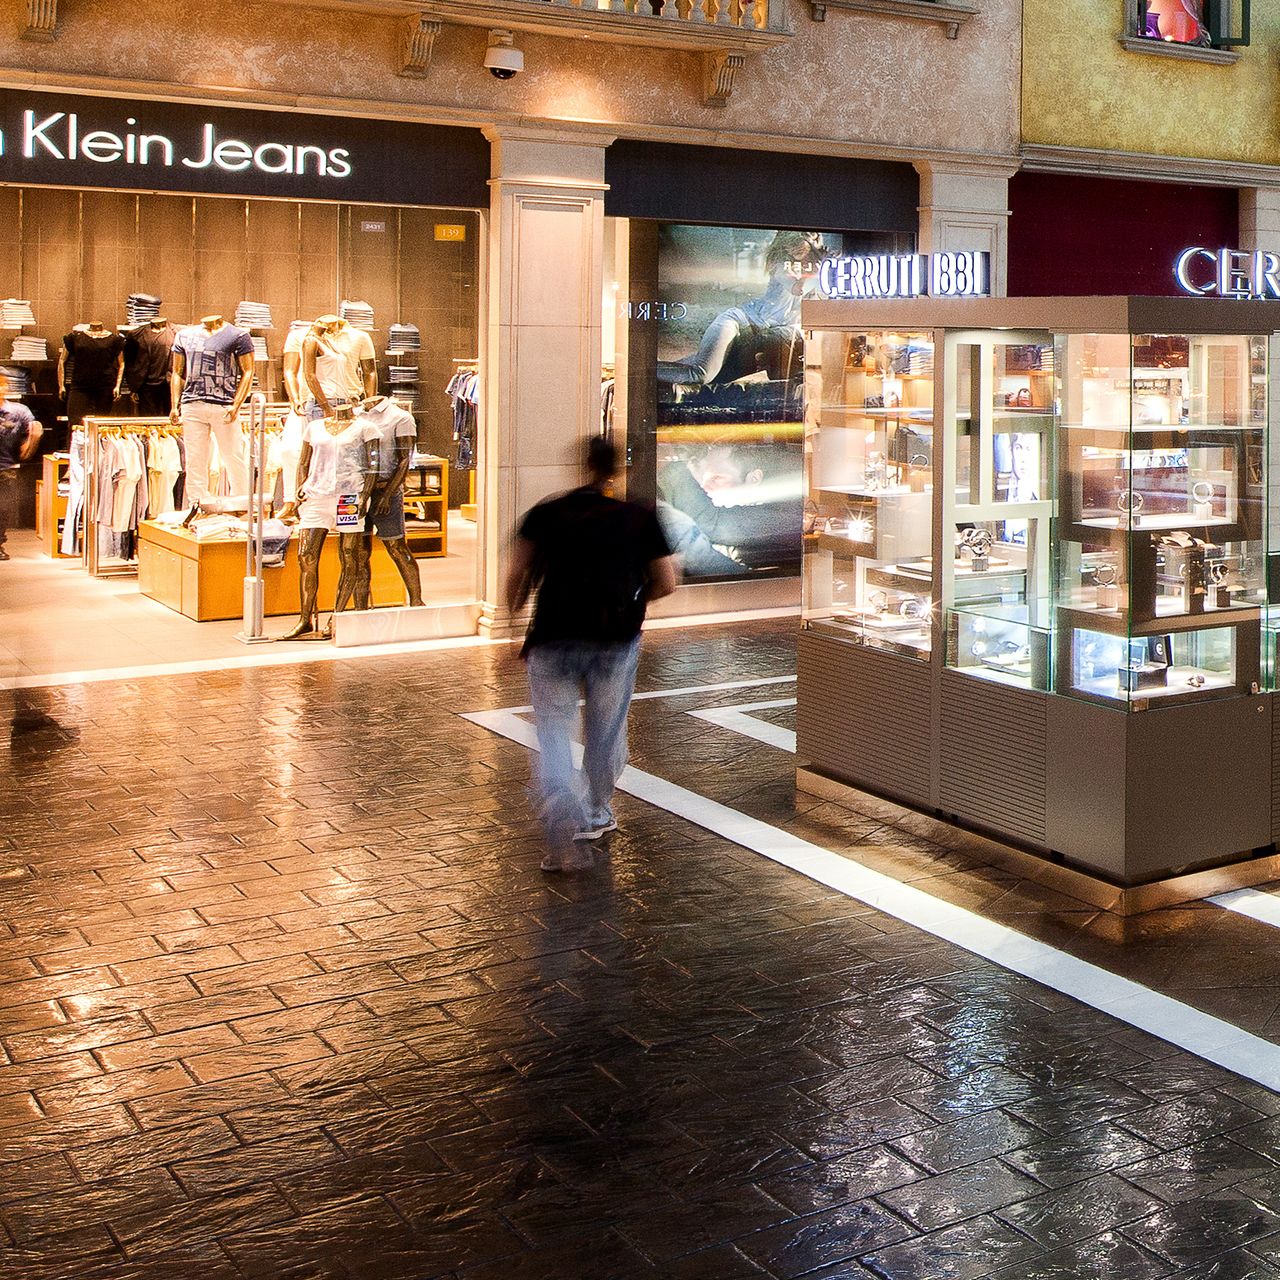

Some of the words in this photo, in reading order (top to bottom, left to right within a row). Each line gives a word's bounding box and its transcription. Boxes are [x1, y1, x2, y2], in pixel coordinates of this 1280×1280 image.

[23, 109, 173, 167] Klein
[181, 123, 352, 178] Jeans
[442, 229, 459, 237] 139
[819, 255, 927, 297] CERRUTI
